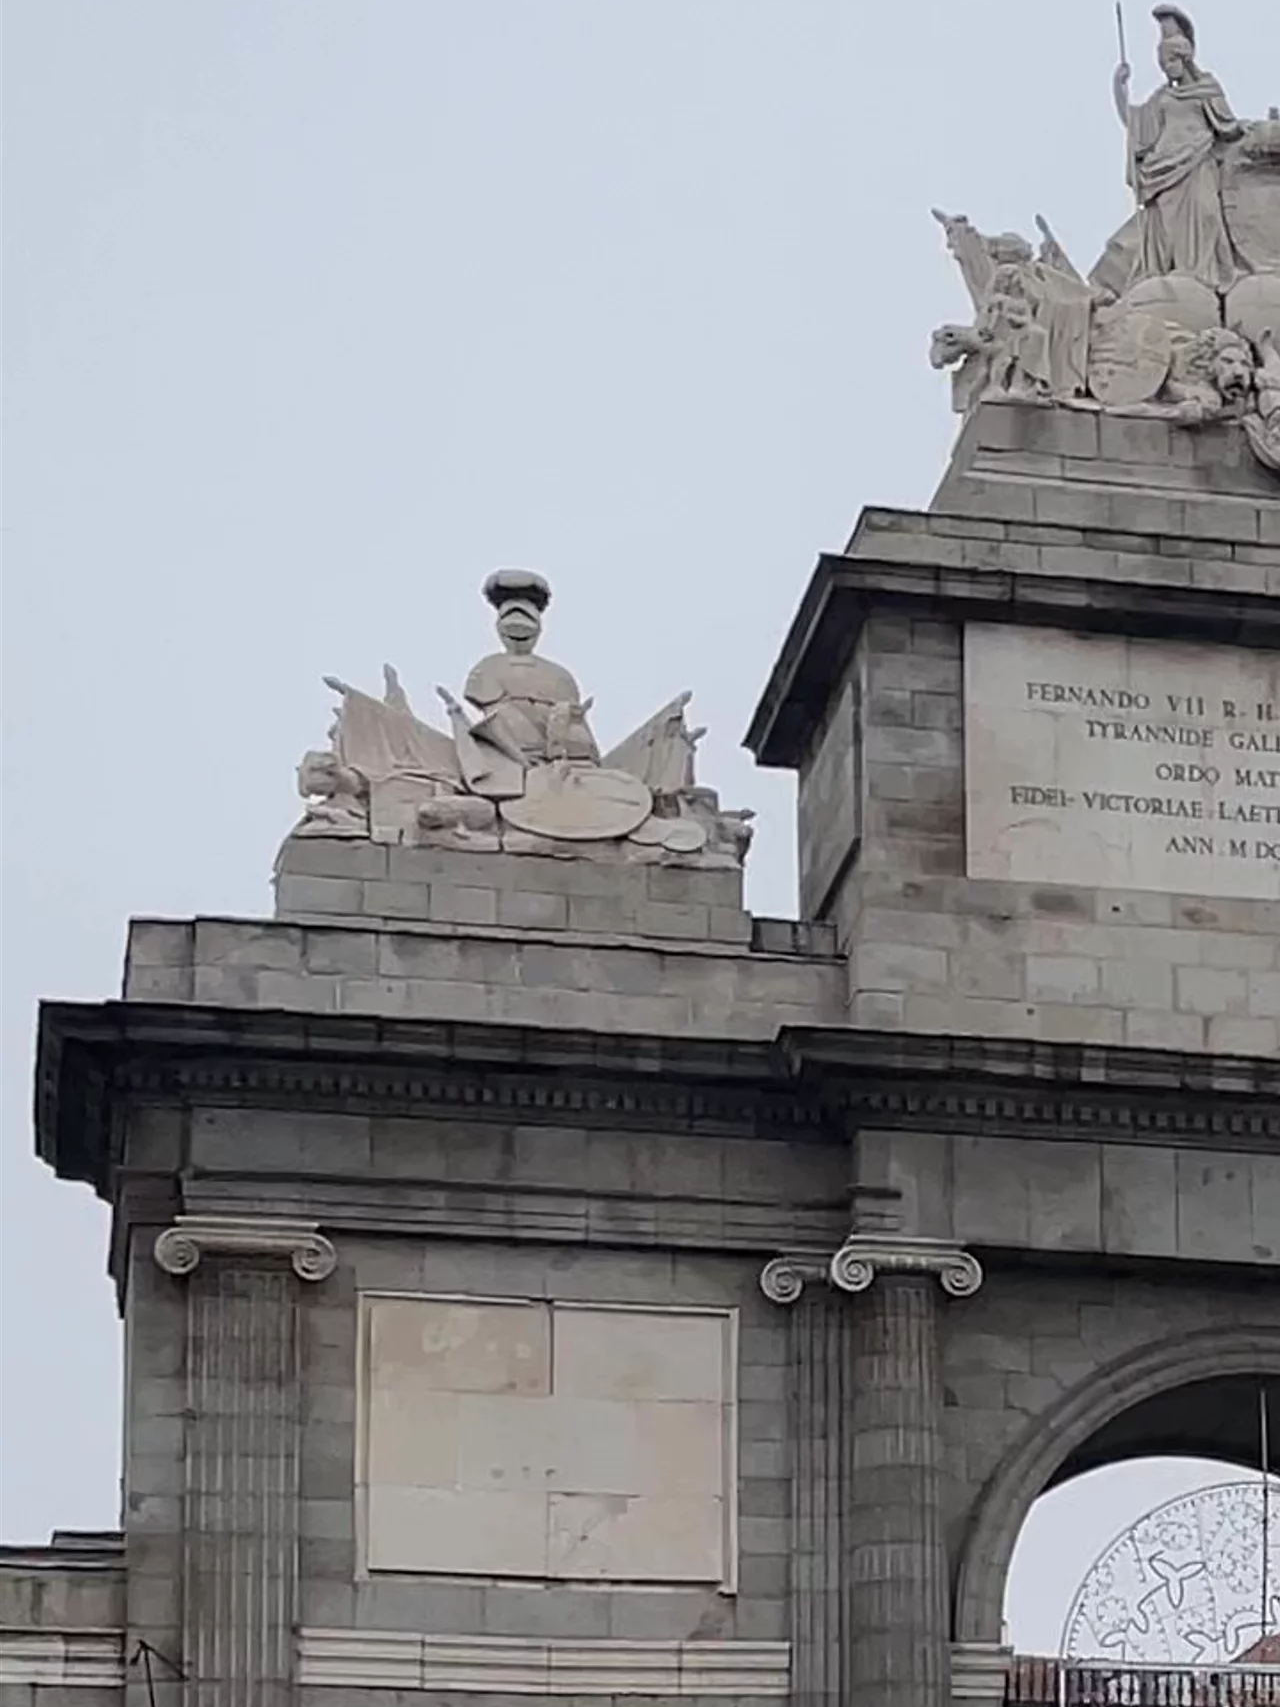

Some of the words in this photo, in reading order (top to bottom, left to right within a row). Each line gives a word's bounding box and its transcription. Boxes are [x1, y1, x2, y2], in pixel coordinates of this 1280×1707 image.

[1026, 682, 1150, 710] FERNANDO
[1167, 695, 1205, 716] VII
[1085, 719, 1214, 749] TYRANNIDE
[1155, 763, 1221, 787] ORDO
